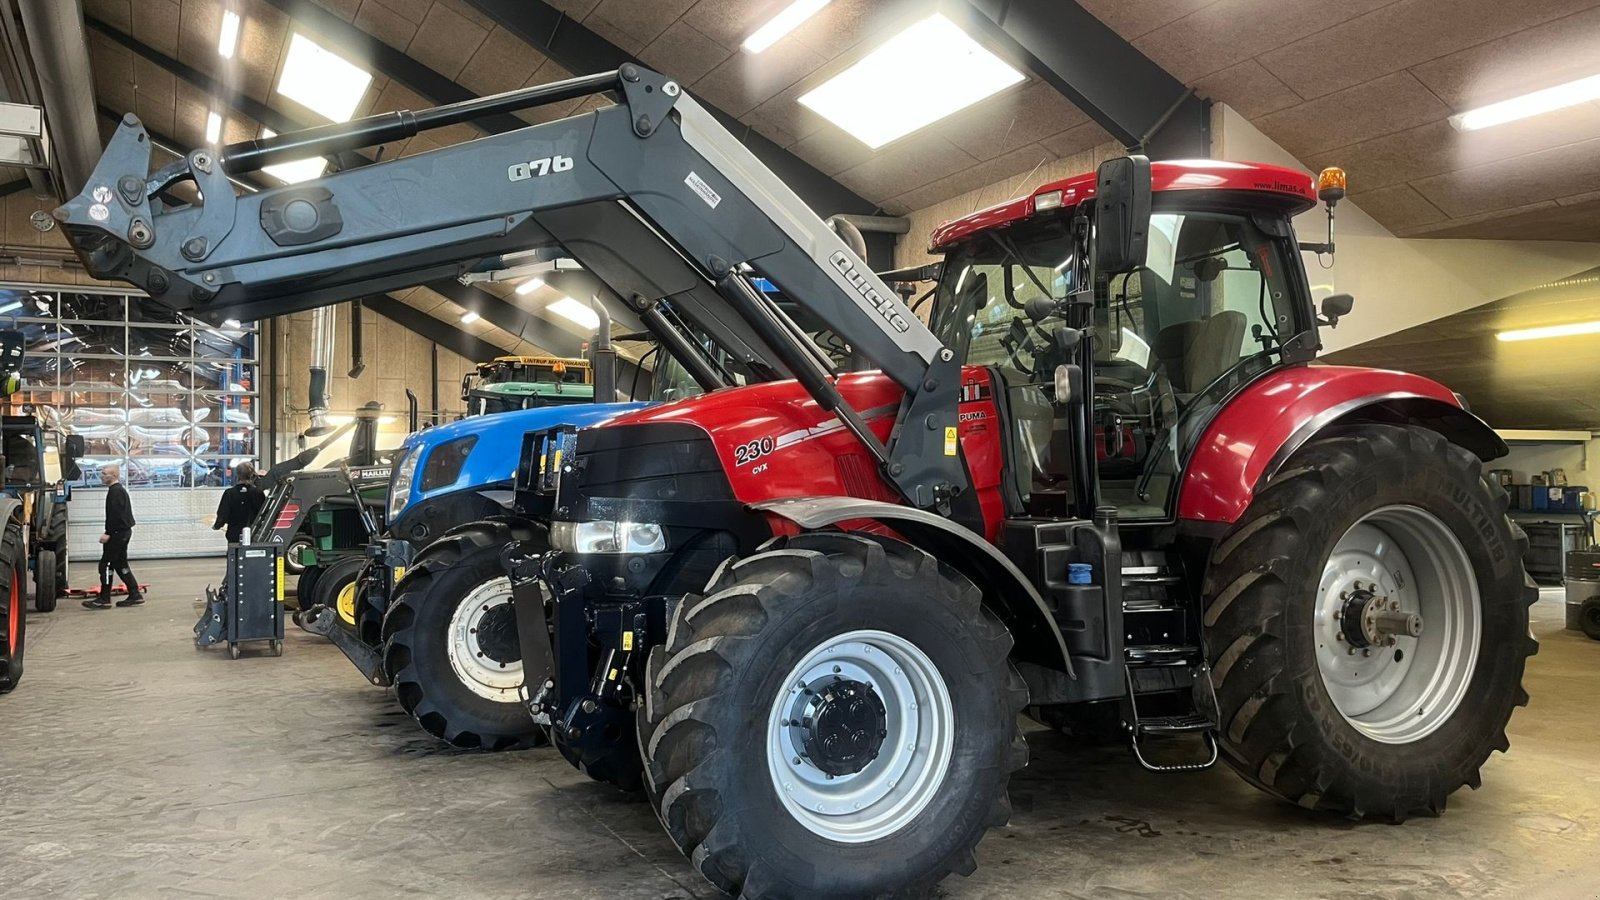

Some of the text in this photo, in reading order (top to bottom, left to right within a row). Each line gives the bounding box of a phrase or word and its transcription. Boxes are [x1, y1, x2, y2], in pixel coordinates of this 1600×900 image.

[508, 155, 574, 182] Q76
[829, 250, 910, 334] Quicke
[959, 411, 987, 422] PUMA
[735, 435, 774, 467] 230
[362, 468, 392, 478] MAILLEU
